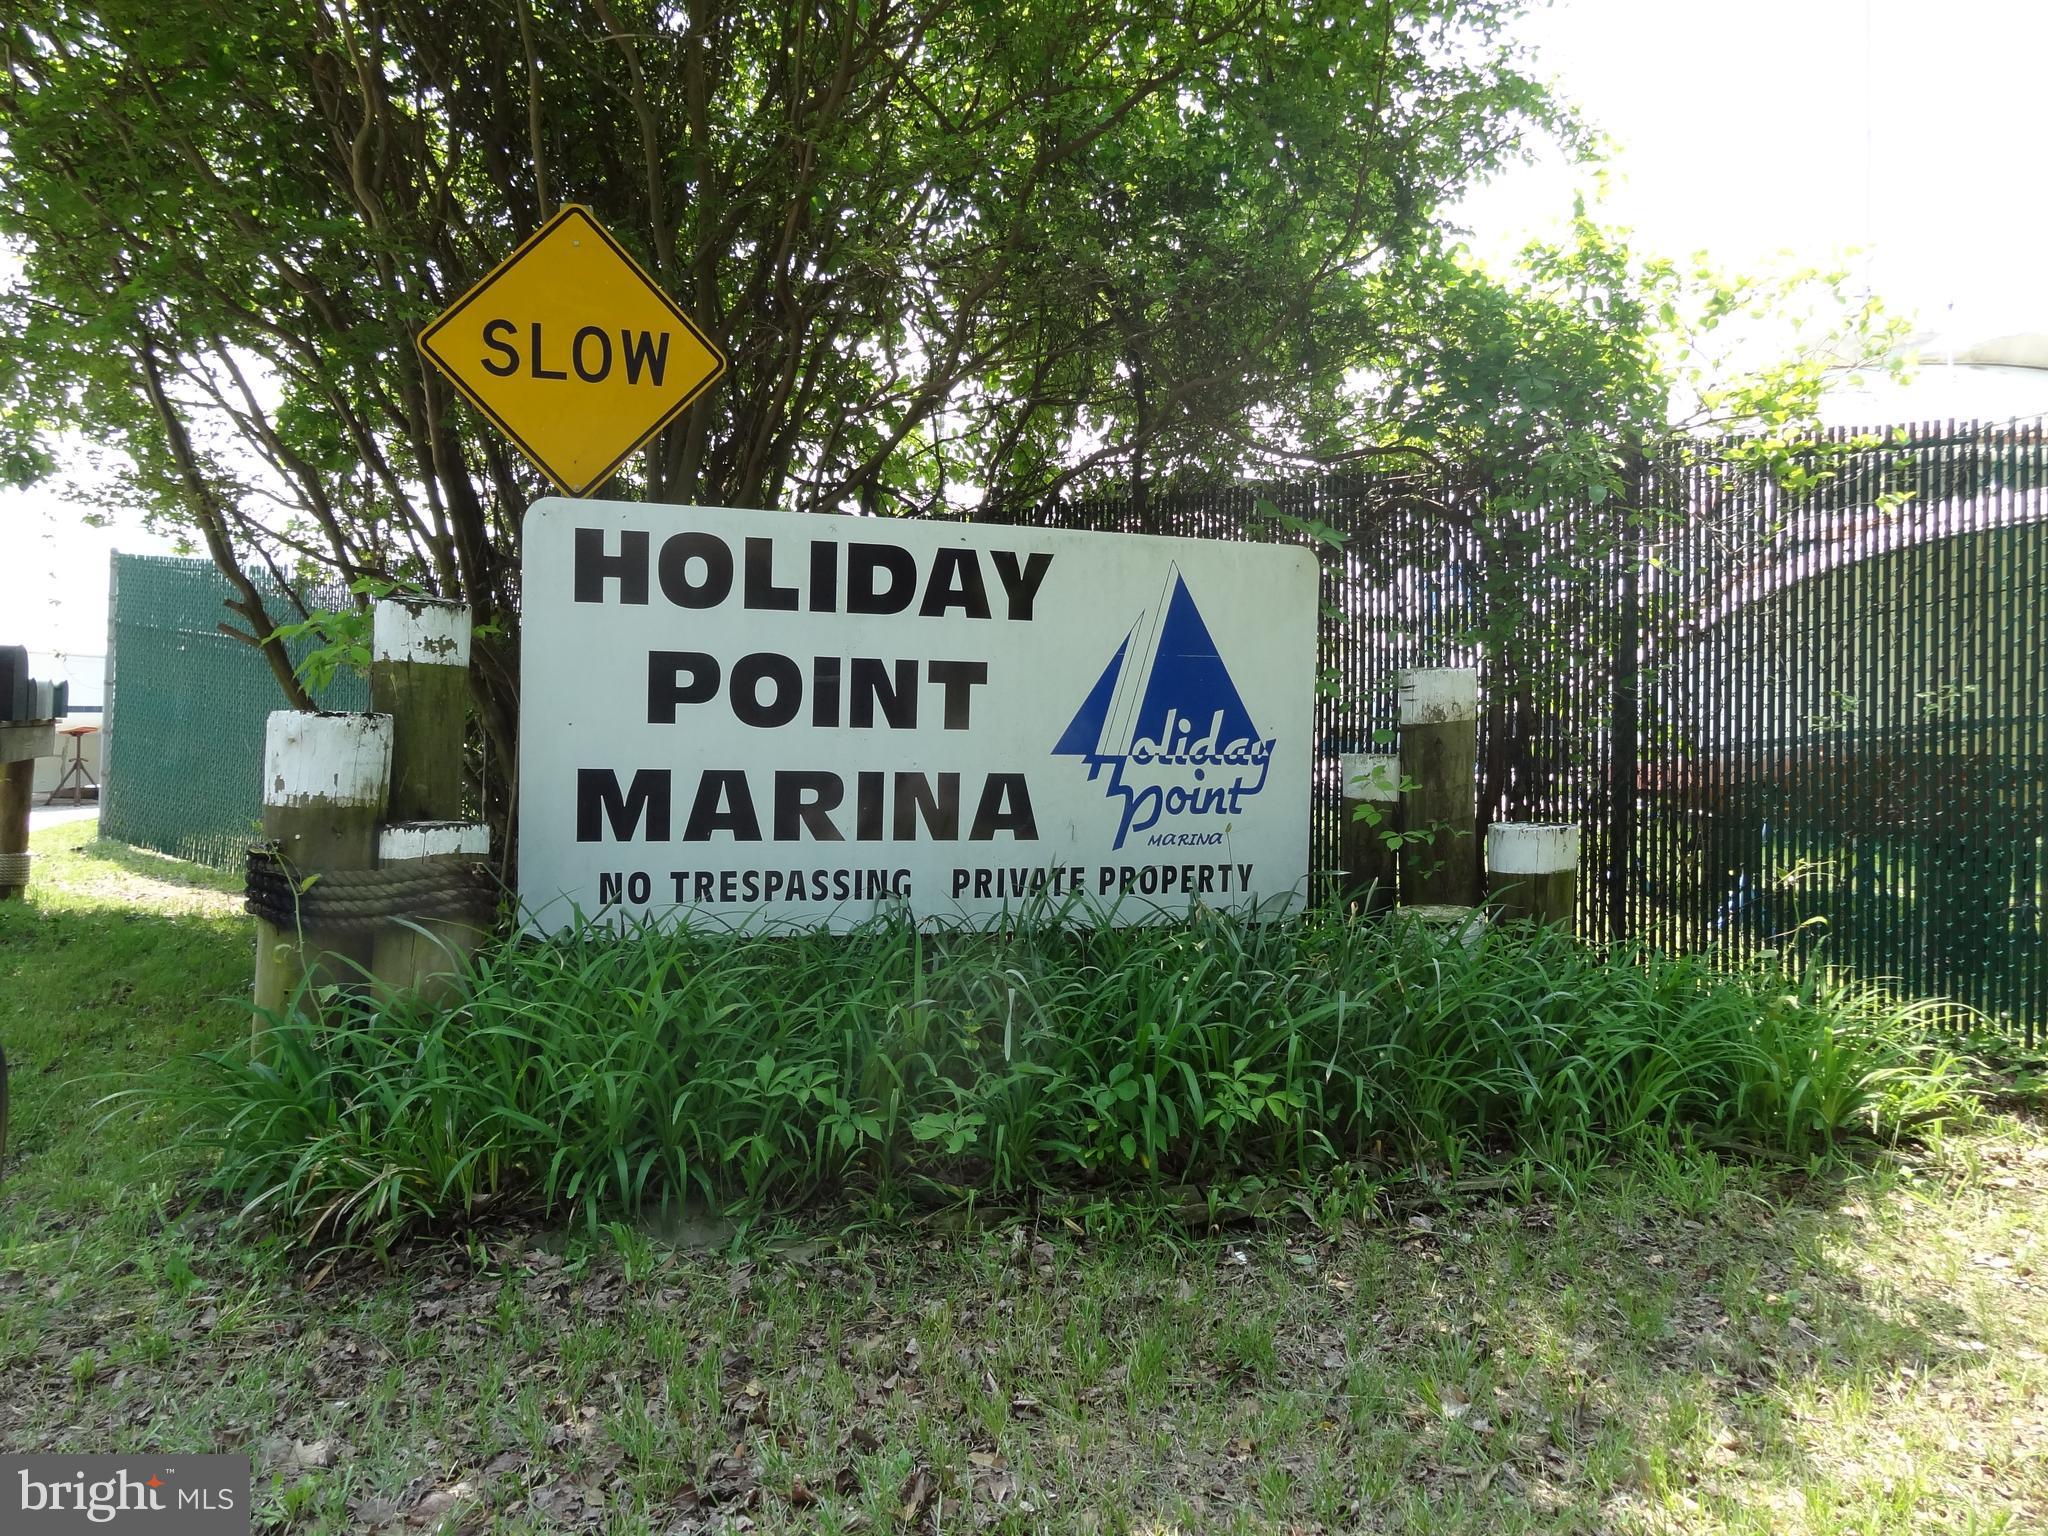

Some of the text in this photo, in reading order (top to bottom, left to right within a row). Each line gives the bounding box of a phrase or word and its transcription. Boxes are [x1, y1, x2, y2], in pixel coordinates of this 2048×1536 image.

[480, 319, 670, 387] SLOW
[574, 527, 1054, 621] HOLIDAY
[647, 651, 988, 731] POINT
[1081, 708, 1277, 798] Holiday
[577, 768, 1039, 842] MARINA
[599, 863, 1255, 904] NO TRESPASSING PRIVATE PROPERTY
